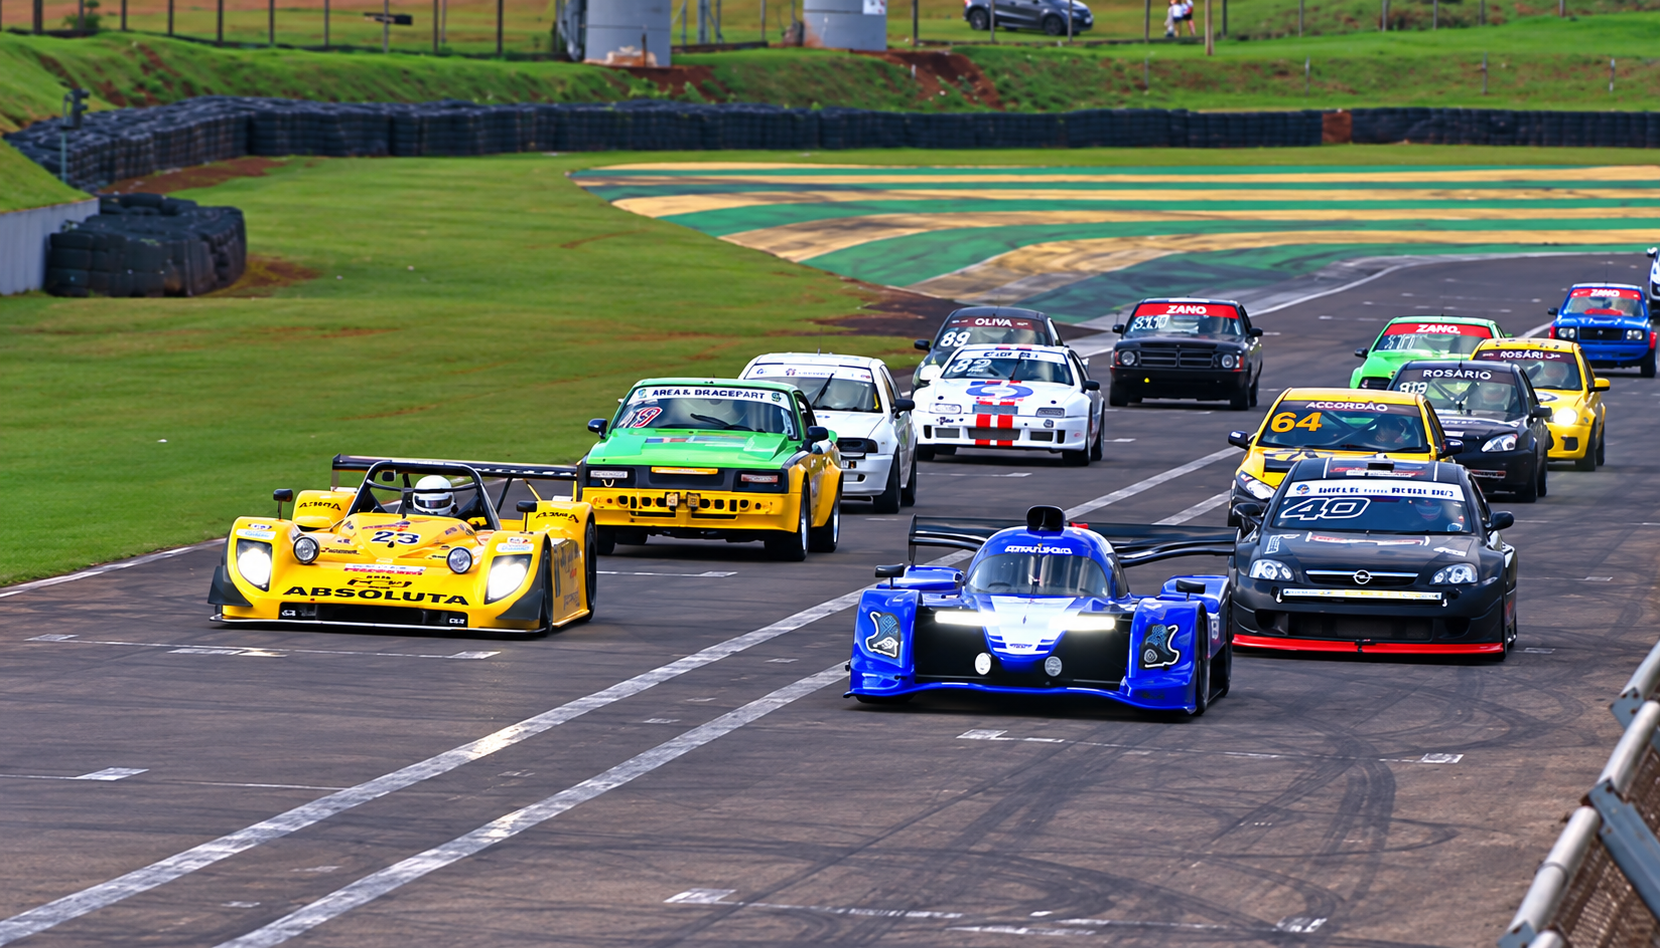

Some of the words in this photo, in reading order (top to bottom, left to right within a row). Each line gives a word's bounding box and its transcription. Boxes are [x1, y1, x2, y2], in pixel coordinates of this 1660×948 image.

[1590, 288, 1621, 298] ZANO
[1166, 305, 1207, 315] ZANO
[974, 318, 1012, 327] OLIVA
[940, 331, 970, 347] 89
[1270, 411, 1323, 433] 64
[1280, 497, 1371, 521] 40
[371, 530, 421, 545] 23
[282, 586, 470, 606] ABSOLUTA
